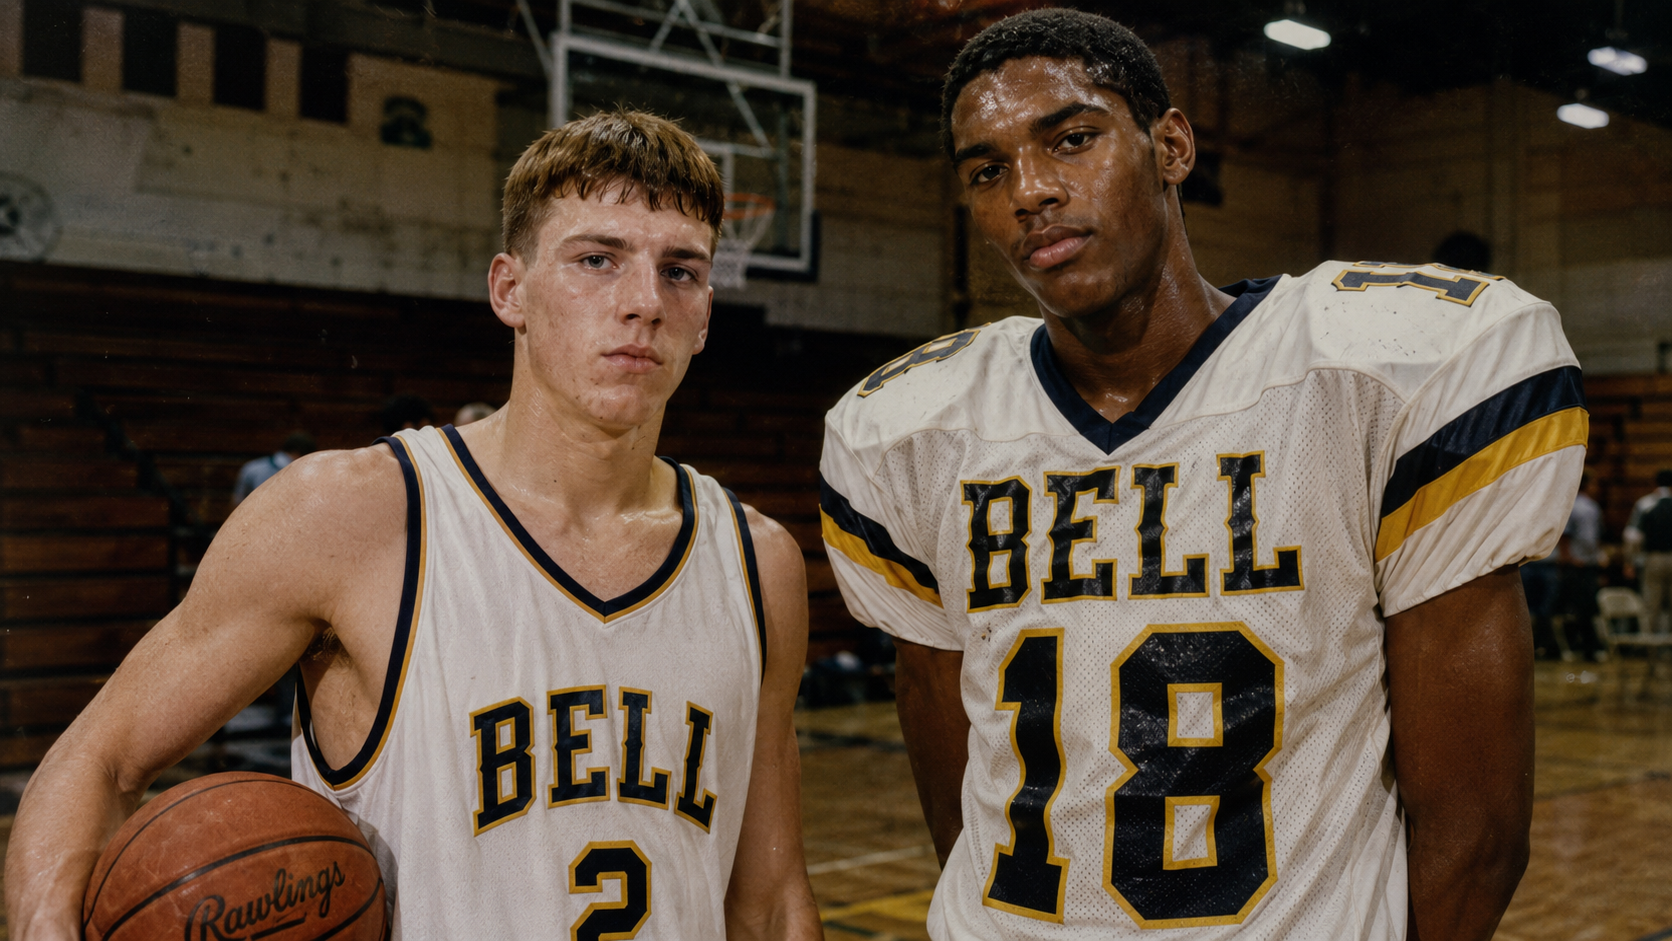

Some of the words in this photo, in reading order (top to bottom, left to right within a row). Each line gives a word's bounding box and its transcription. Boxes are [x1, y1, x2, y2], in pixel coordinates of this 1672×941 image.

[1331, 251, 1506, 307] 1
[960, 450, 1305, 614] BELL
[469, 684, 718, 837] BELL
[982, 621, 1285, 929] 18
[184, 861, 346, 941] Rawlings
[568, 840, 652, 941] 2
